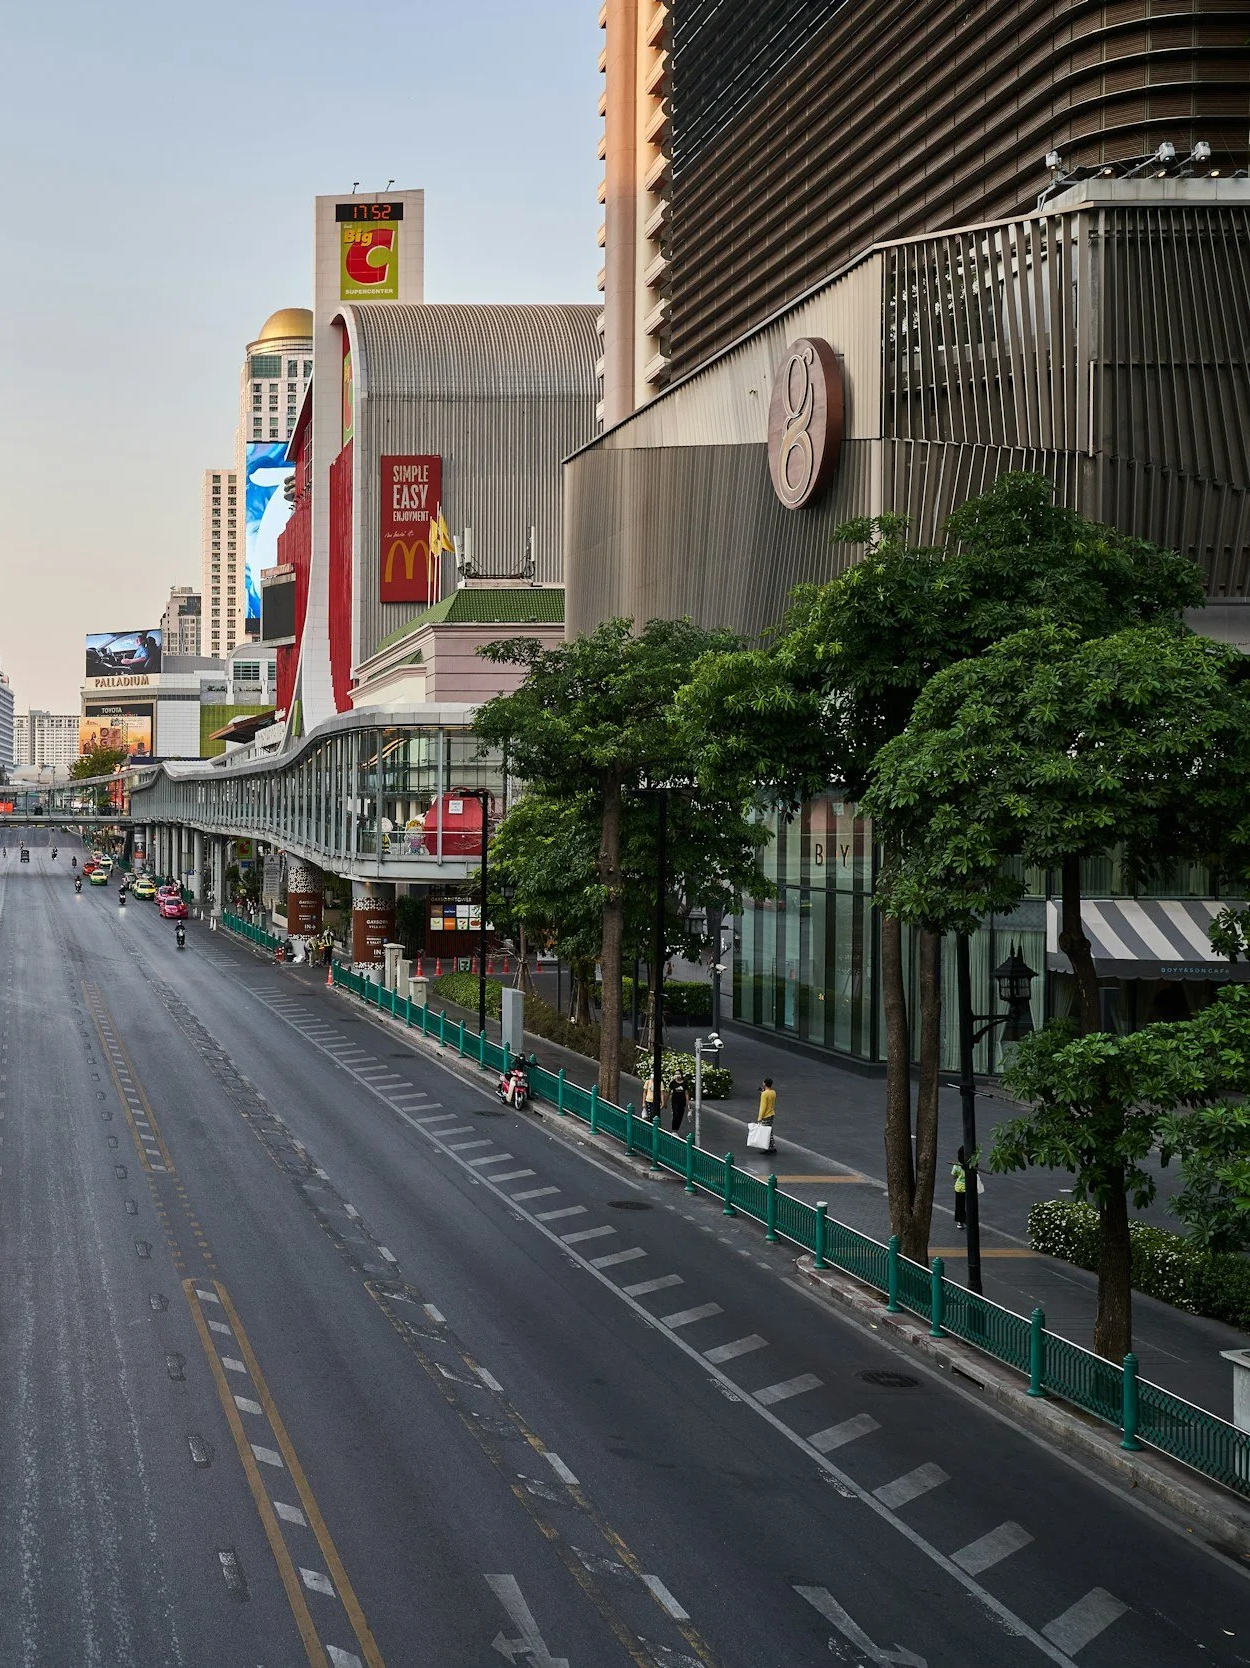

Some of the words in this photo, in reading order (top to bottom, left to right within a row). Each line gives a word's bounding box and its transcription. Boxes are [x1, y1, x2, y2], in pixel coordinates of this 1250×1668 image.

[343, 228, 373, 246] Big
[393, 465, 429, 483] SIMPLE
[393, 484, 429, 509] EASY
[393, 511, 429, 522] ENJOYMENT
[95, 674, 150, 688] PALLADIUM
